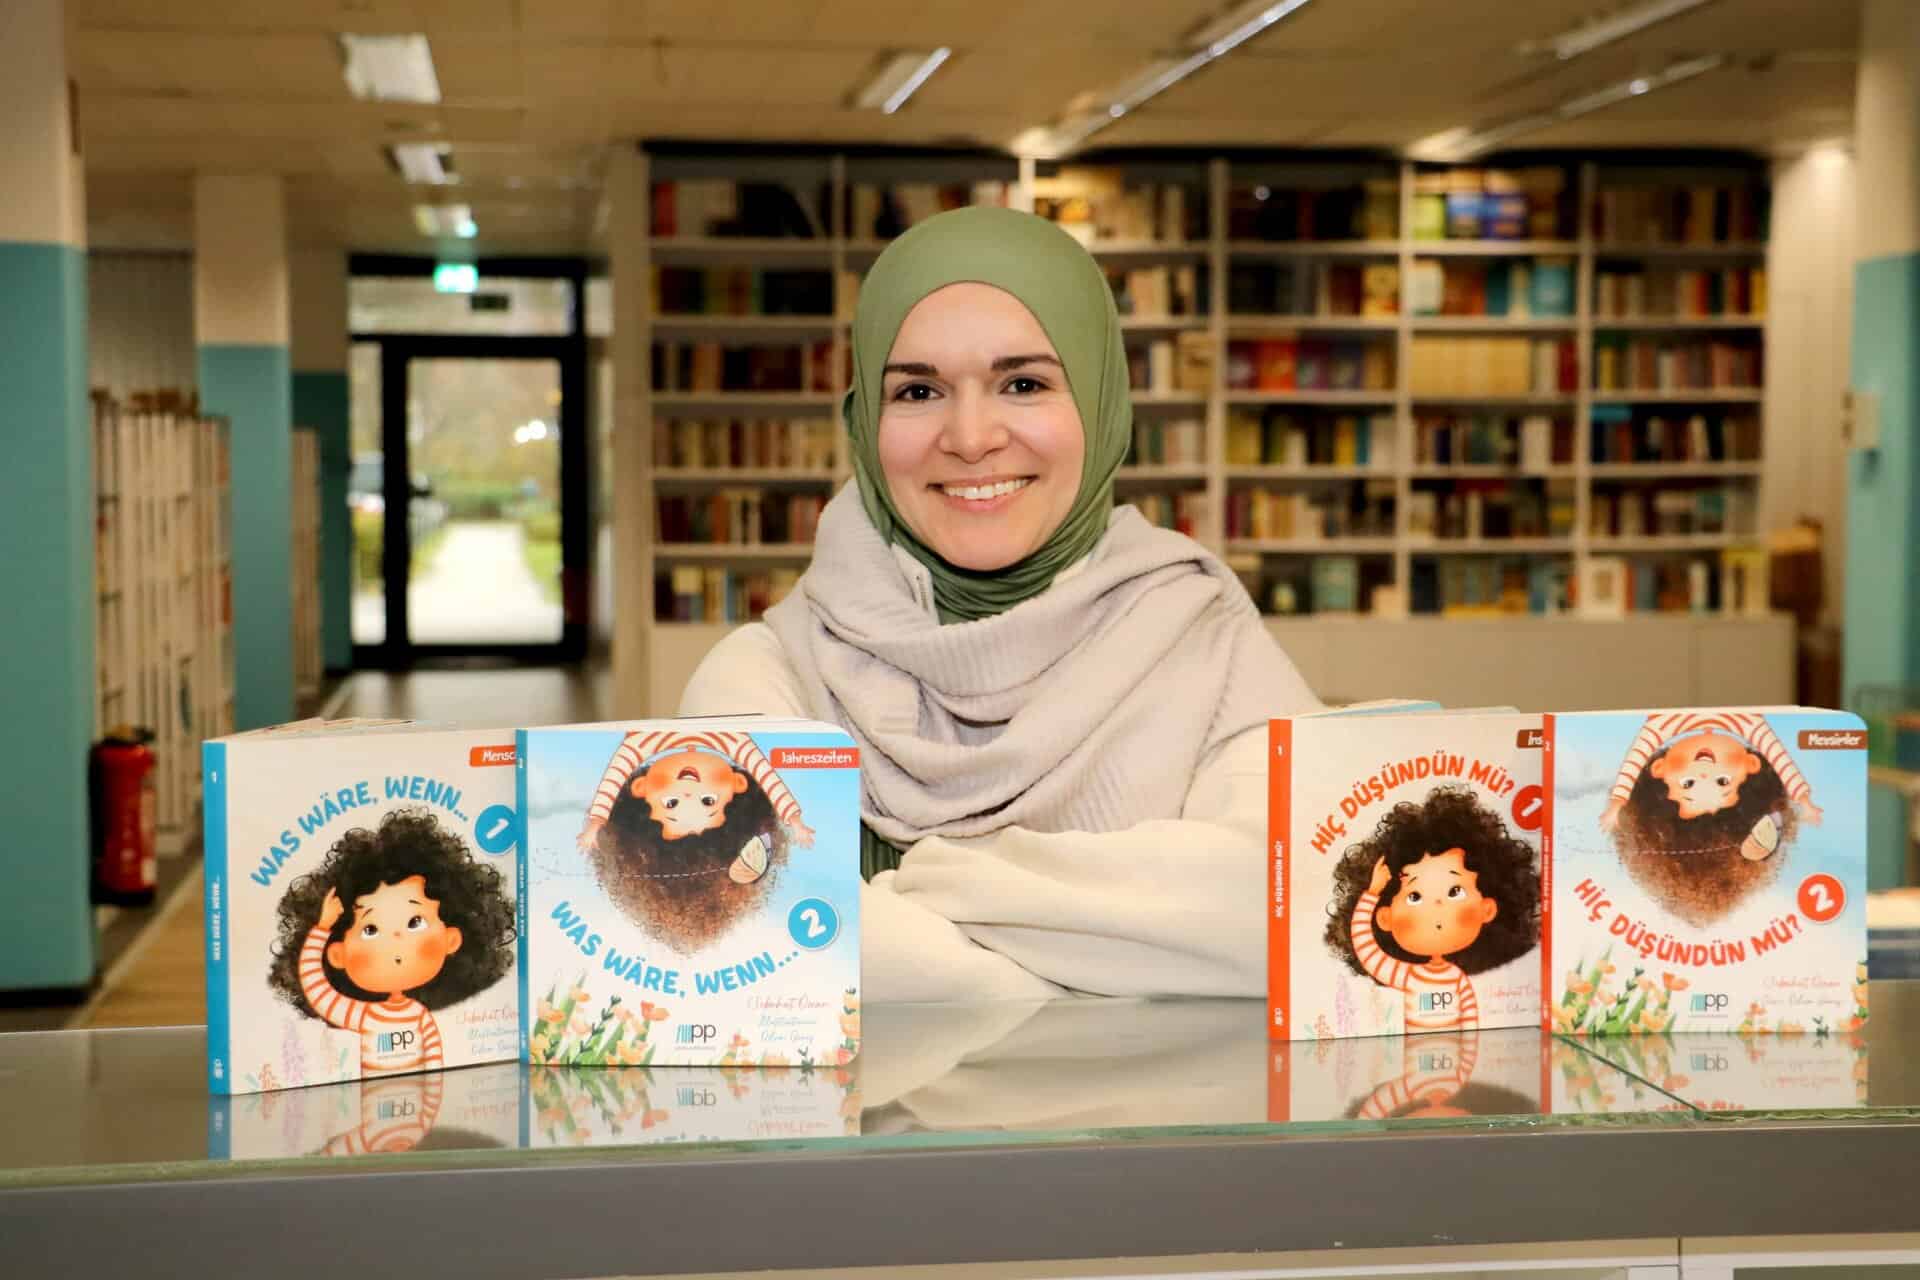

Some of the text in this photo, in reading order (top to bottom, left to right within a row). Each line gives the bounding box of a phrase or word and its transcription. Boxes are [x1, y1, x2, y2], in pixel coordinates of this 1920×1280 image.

[482, 750, 516, 763] Mensc
[782, 750, 853, 764] Jahreszeiten
[1311, 750, 1515, 854] HİÇ DÜŞÜNDÜN MÜ?
[1521, 797, 1543, 817] 1
[250, 775, 469, 887] WAS WÄRE, WENN...
[486, 818, 509, 840] 1
[1808, 883, 1835, 912] 2
[801, 908, 827, 938] 2
[1573, 878, 1802, 967] HİÇ DÜŞÜNDÜN MÜ?
[551, 901, 799, 998] WAS WÄRE, WENN...
